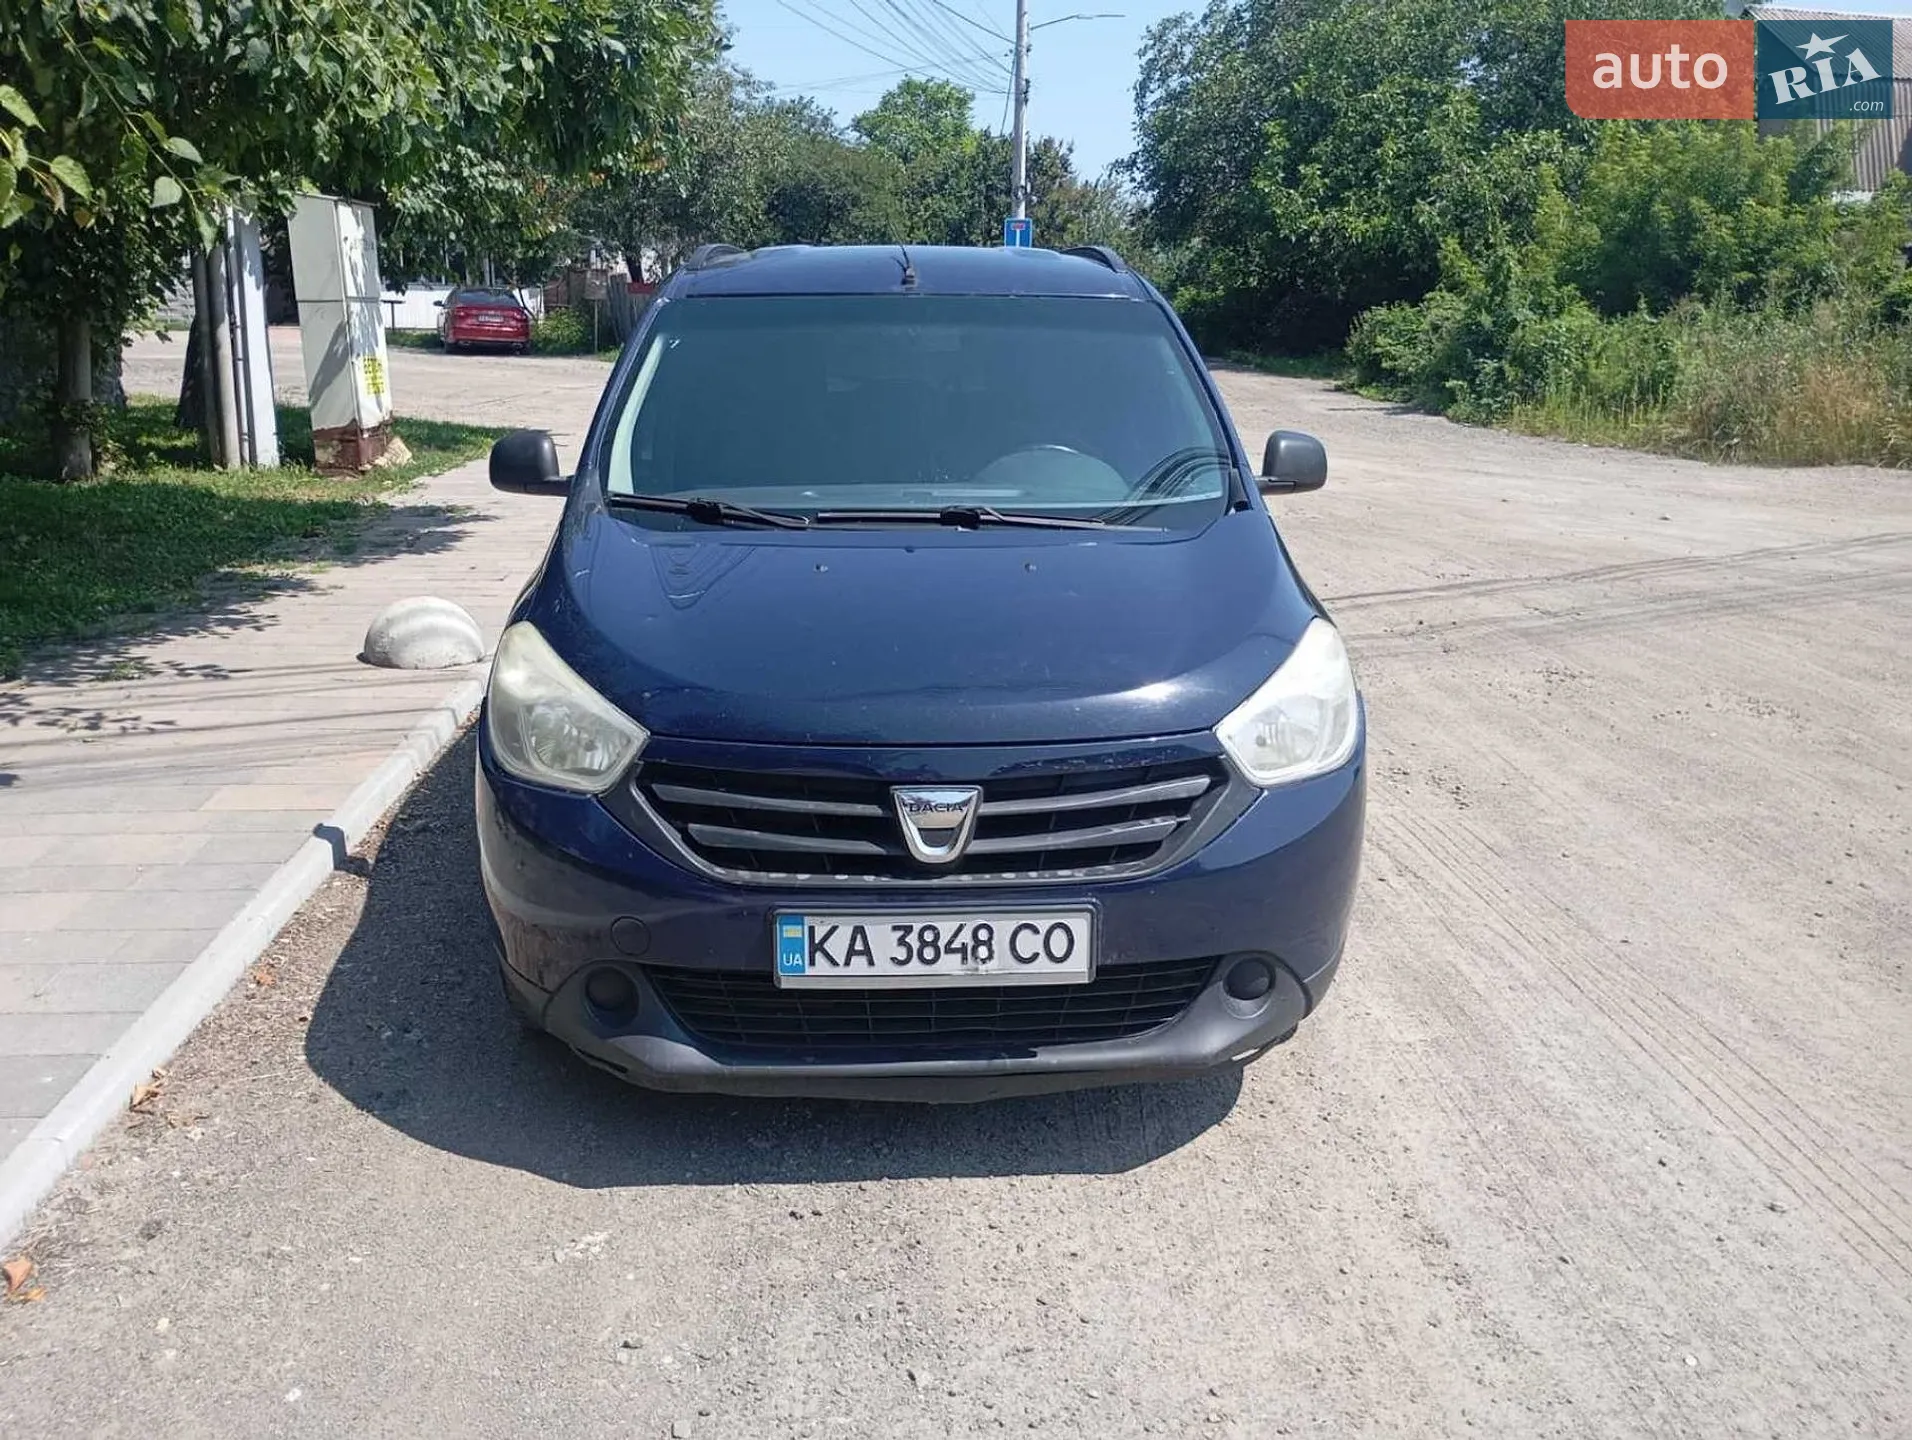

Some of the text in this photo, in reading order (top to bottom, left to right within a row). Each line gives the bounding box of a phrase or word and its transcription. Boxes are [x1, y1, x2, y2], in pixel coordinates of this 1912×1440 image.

[909, 803, 963, 812] DACIA
[808, 922, 1075, 967] KA 3848 CO
[783, 952, 803, 966] UA
